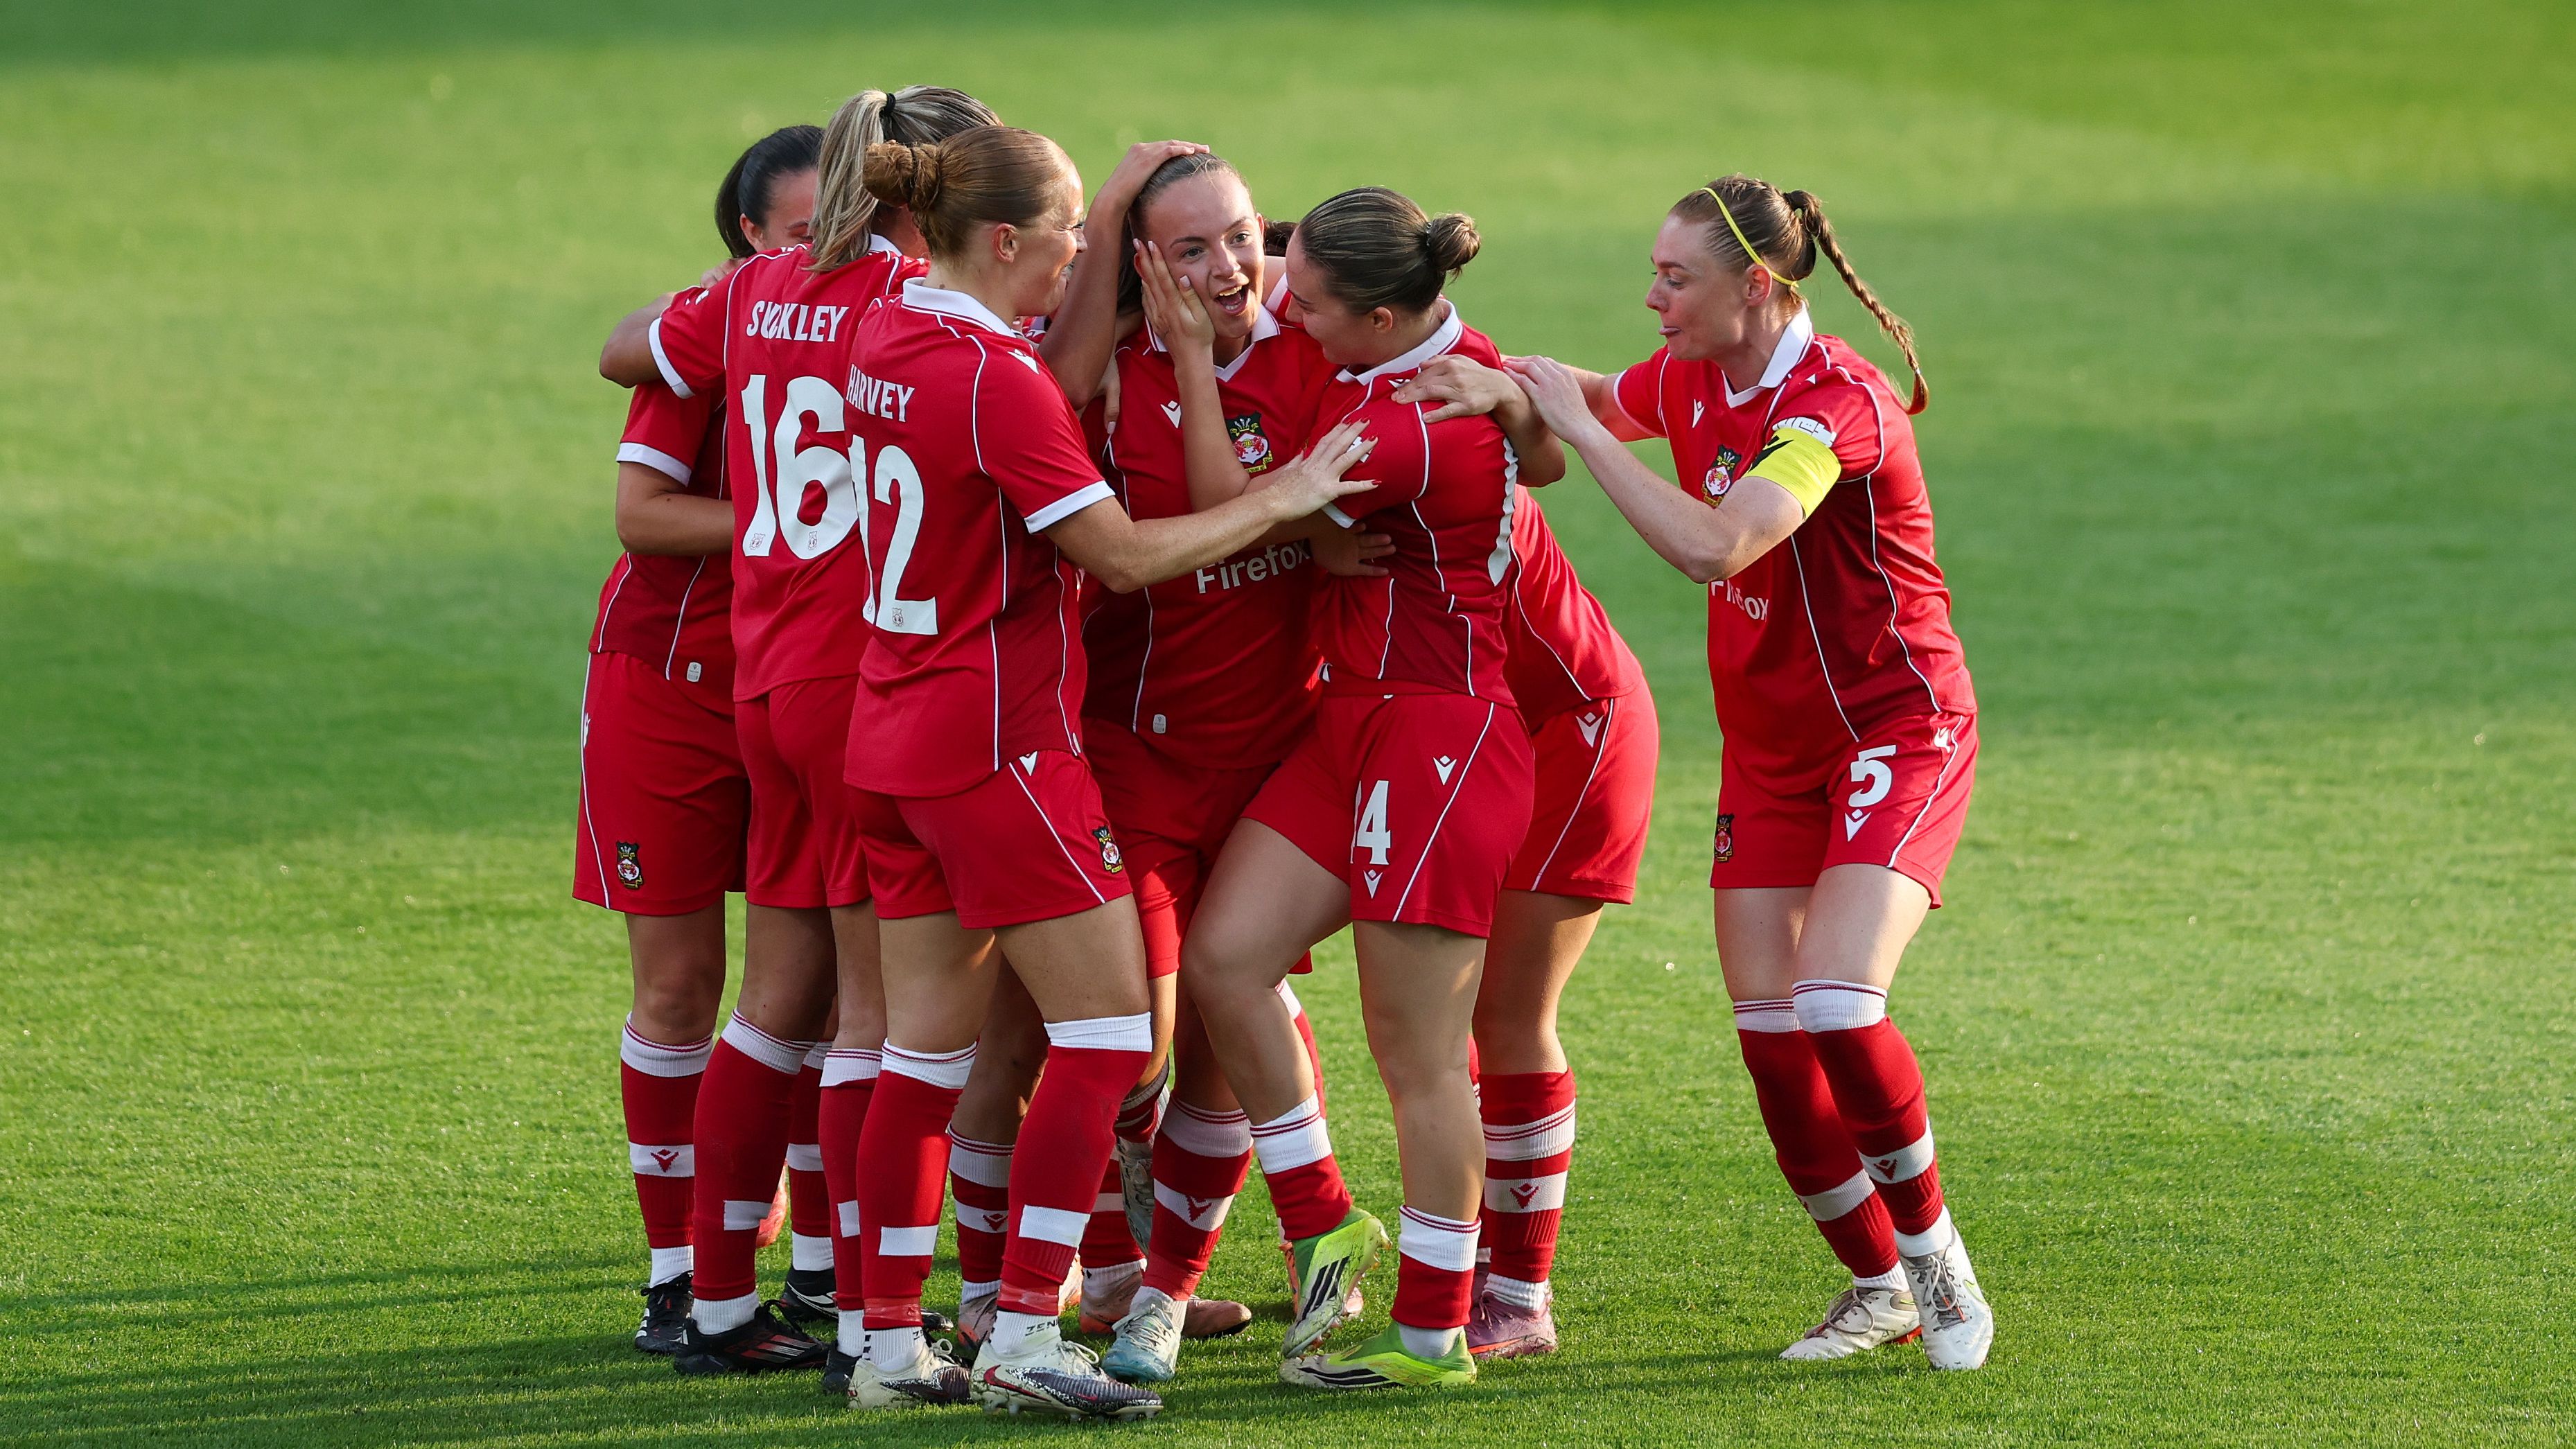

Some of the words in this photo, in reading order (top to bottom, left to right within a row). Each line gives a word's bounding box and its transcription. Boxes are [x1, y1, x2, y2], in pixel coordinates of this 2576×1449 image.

[845, 363, 915, 423] HARVEY
[741, 374, 859, 560] 16
[847, 434, 938, 635] 12
[1195, 541, 1310, 594] Firefox
[1848, 744, 1896, 807] 5
